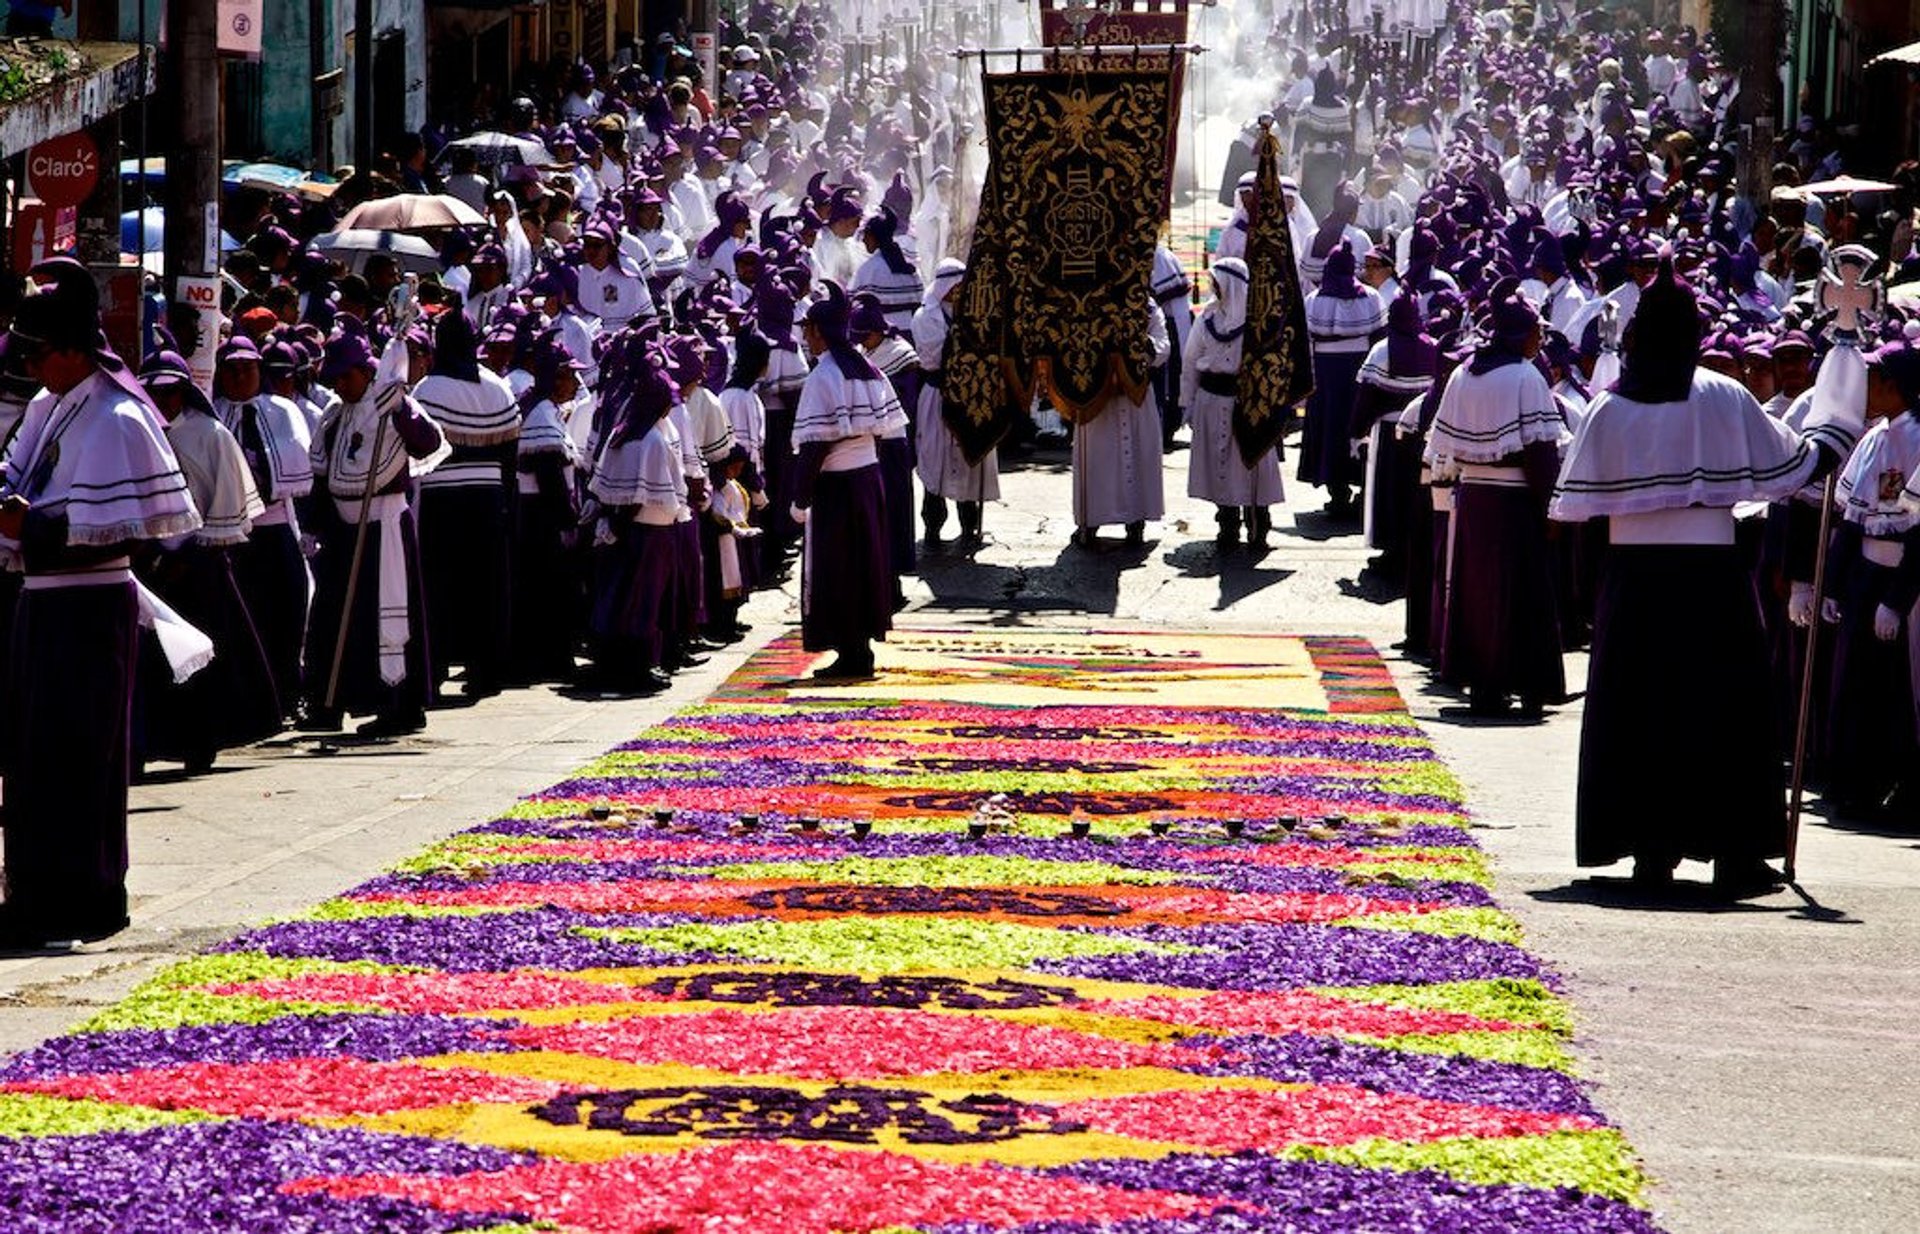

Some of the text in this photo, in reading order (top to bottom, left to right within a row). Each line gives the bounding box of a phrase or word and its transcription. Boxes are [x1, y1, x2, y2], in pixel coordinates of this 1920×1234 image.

[32, 156, 84, 177] Claro
[1065, 223, 1093, 243] REY
[186, 286, 214, 302] NO
